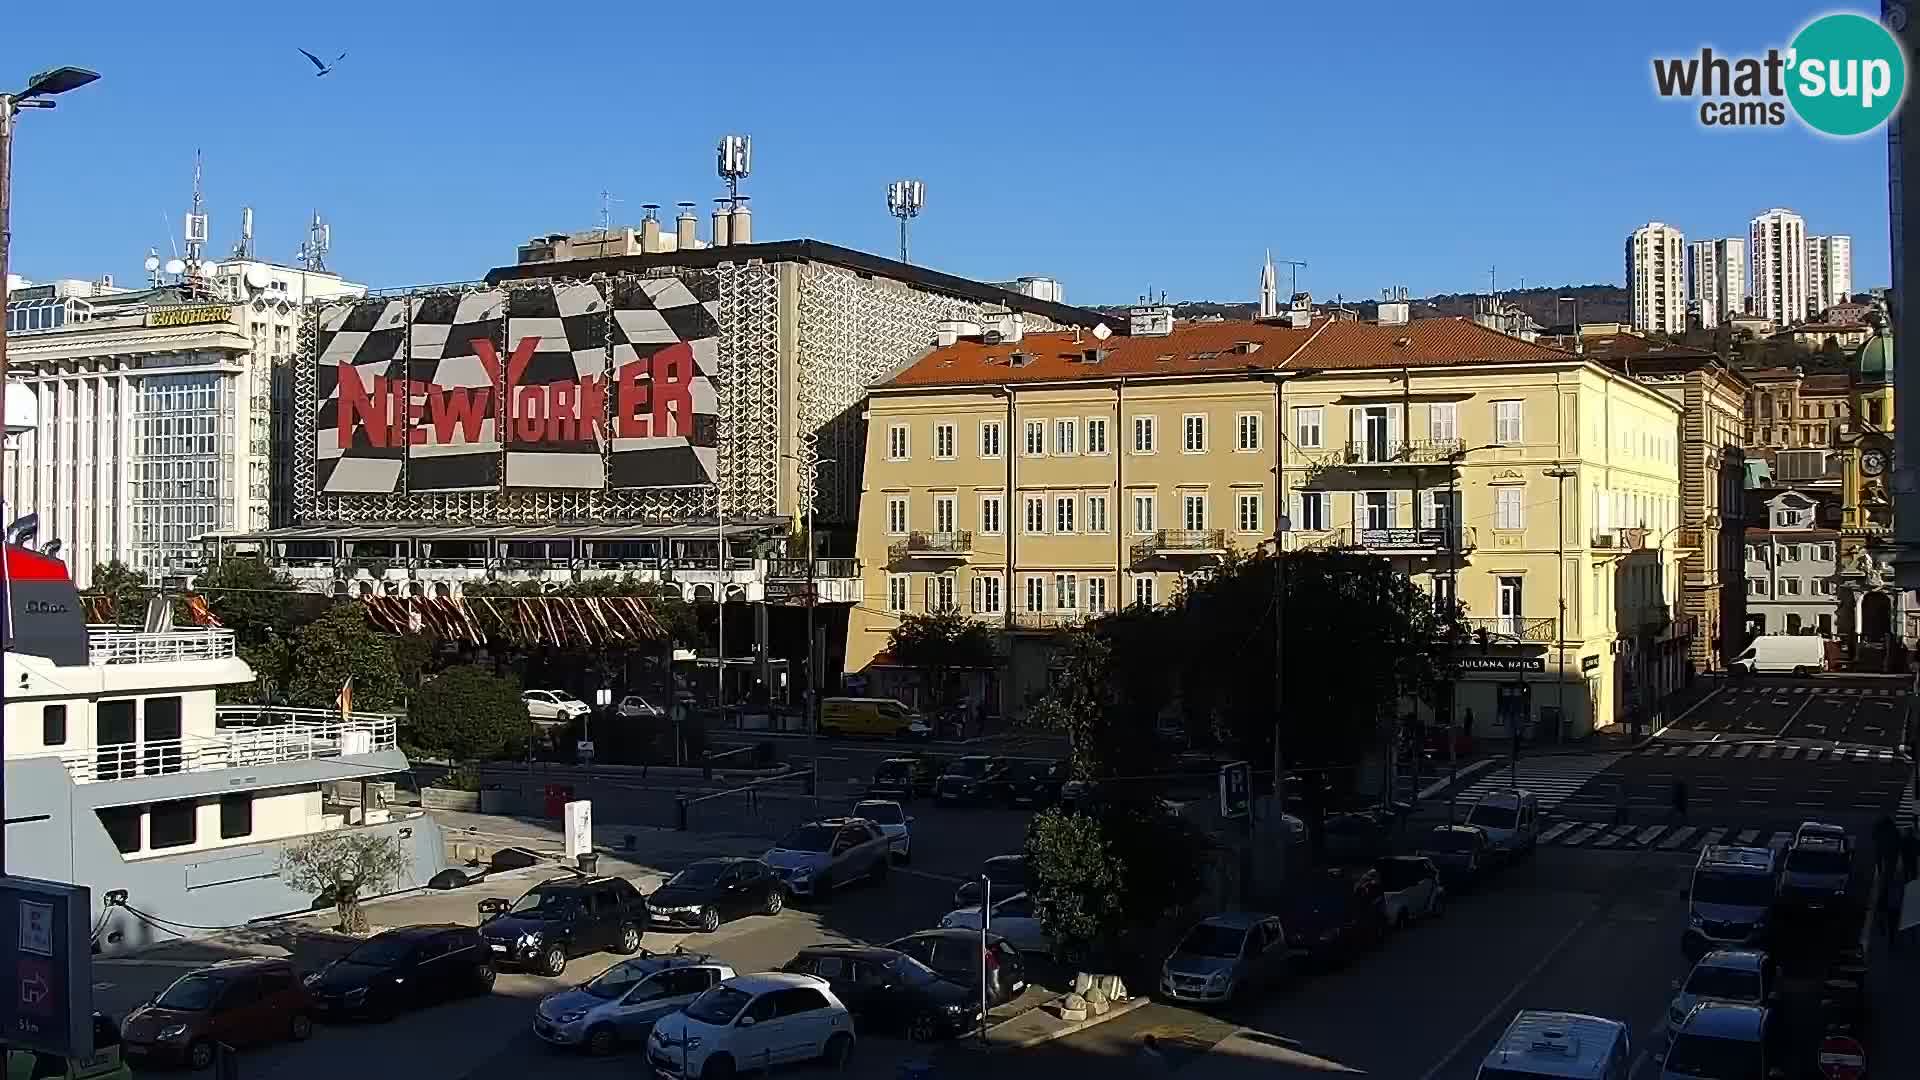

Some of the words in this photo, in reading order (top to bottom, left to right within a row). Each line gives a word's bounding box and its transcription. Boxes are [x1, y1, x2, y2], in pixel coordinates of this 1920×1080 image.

[338, 361, 489, 449] NEW
[473, 337, 694, 442] YORKER
[1458, 660, 1504, 668] JULIANA
[1508, 661, 1540, 669] NAILS
